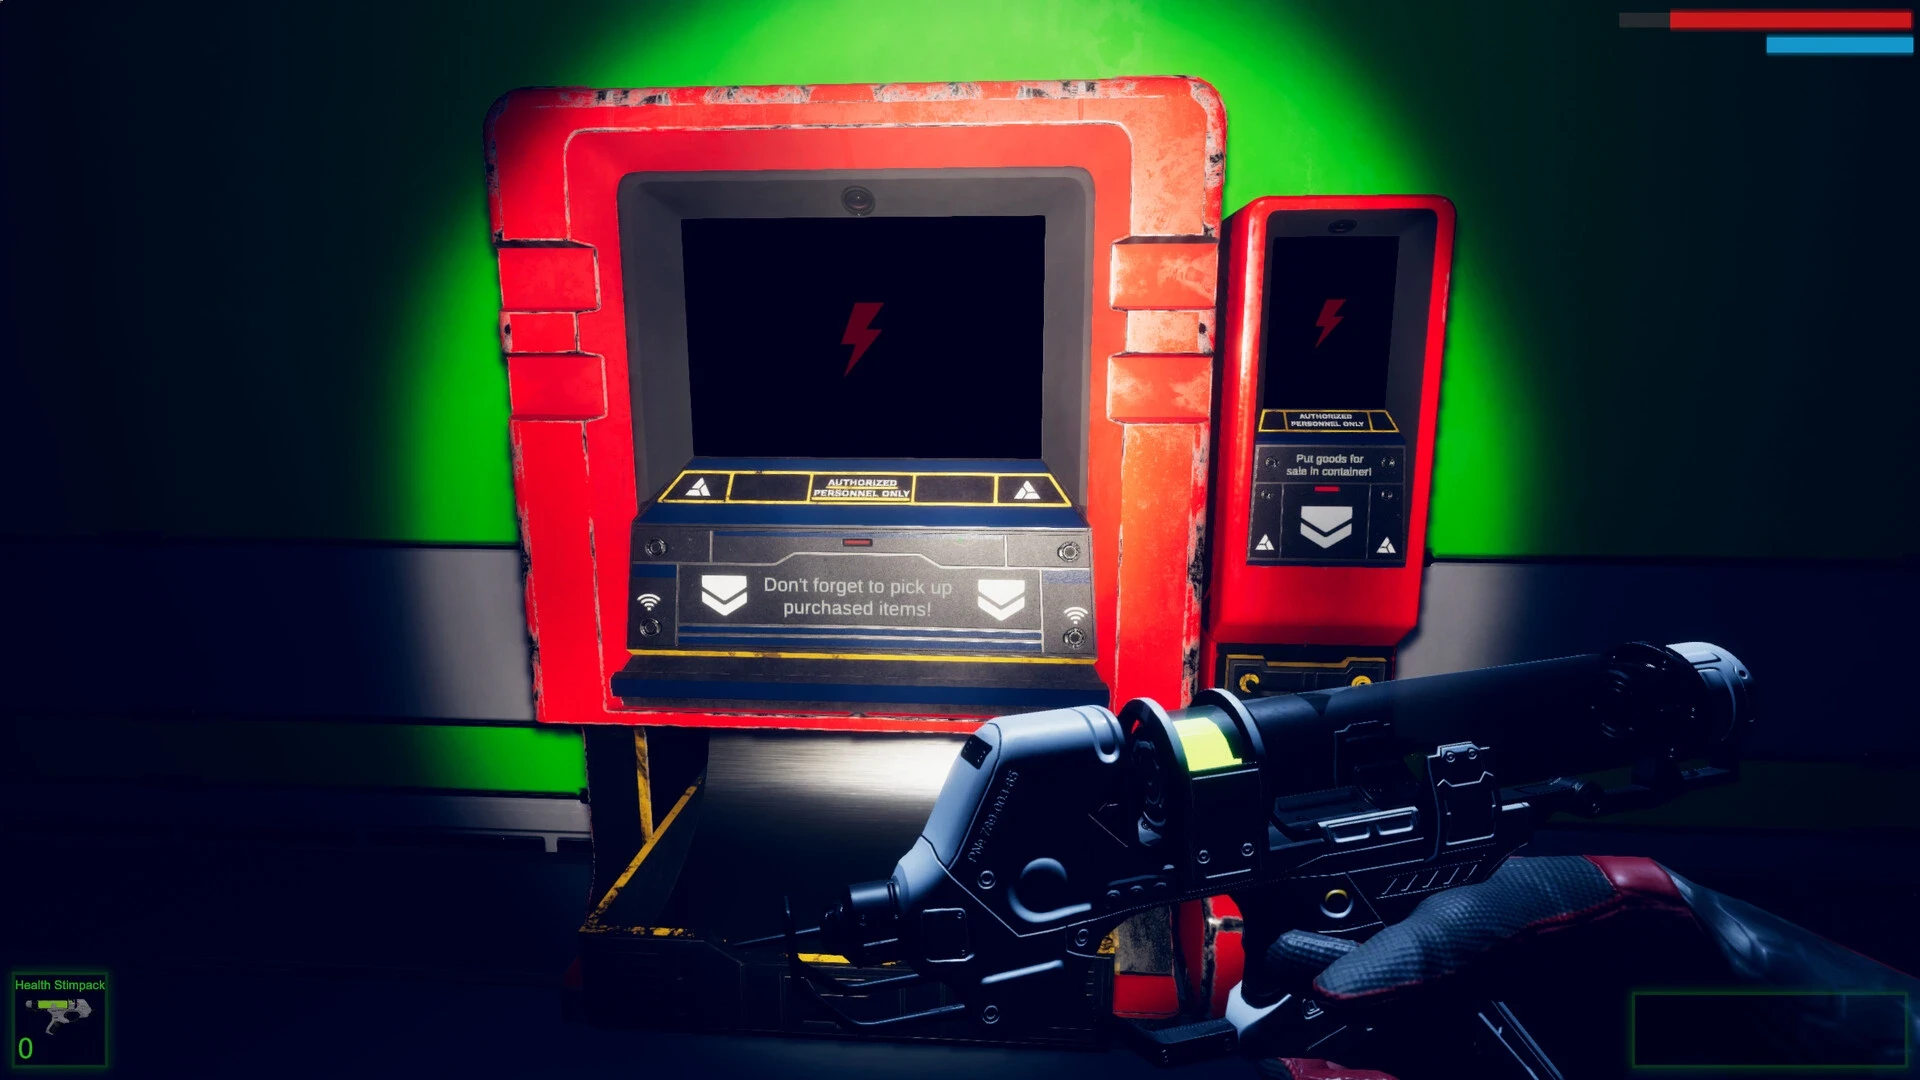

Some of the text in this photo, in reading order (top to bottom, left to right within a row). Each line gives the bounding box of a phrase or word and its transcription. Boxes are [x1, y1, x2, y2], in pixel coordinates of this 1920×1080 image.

[1291, 420, 1342, 428] PERSONNEL
[1296, 454, 1365, 466] Put goods for
[1286, 466, 1372, 477] sale in container!
[827, 478, 898, 487] AUTHORIZED
[813, 489, 911, 498] PERSONNEL ONLY
[764, 577, 952, 599] Don't forget to pick up
[783, 600, 932, 618] purchased items!
